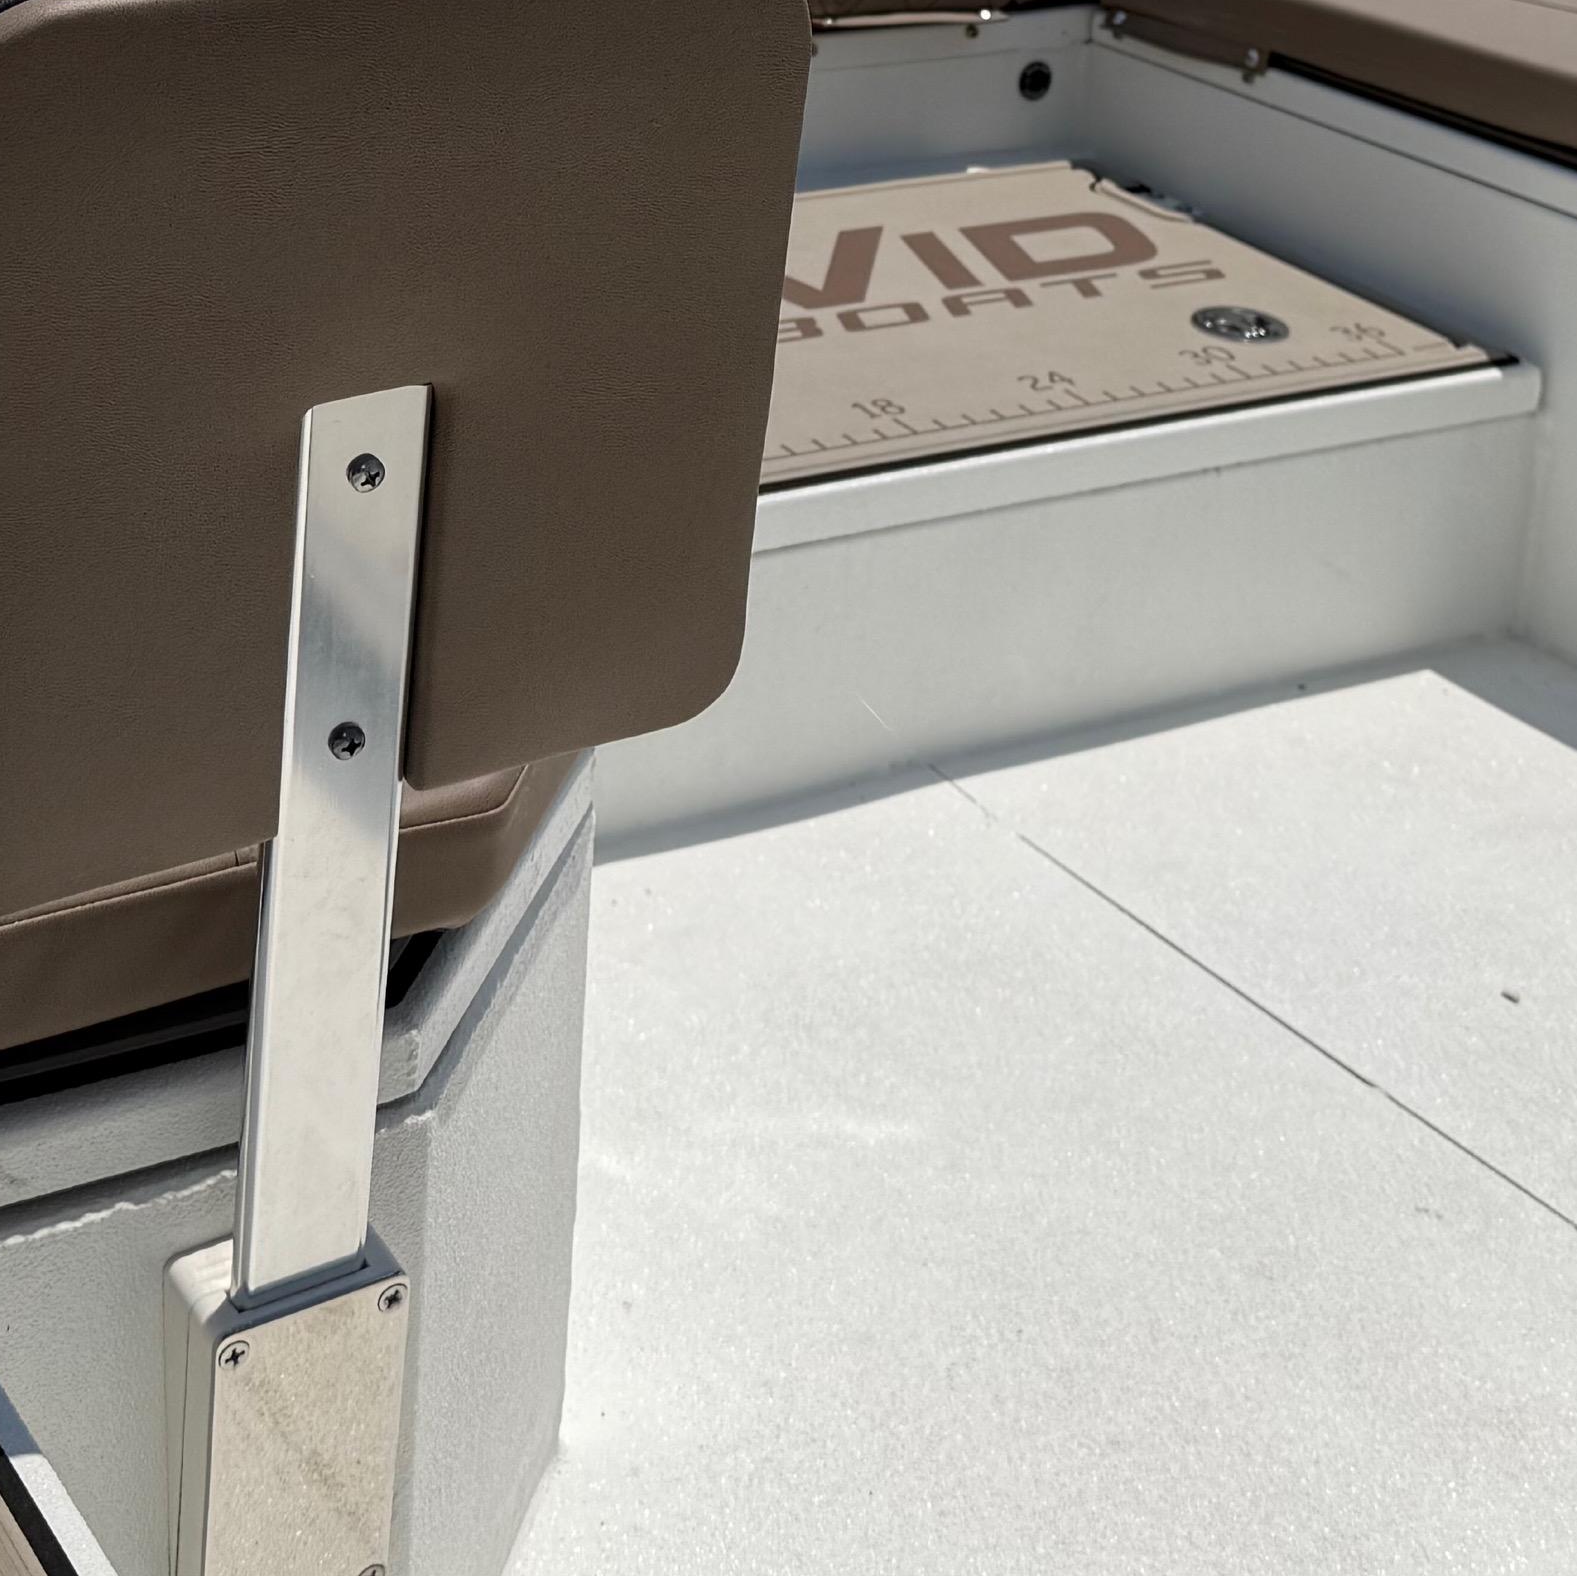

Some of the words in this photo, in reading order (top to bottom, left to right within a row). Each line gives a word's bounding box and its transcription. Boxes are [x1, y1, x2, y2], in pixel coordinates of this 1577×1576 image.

[851, 398, 906, 420] 18
[1018, 370, 1076, 393] 24
[1179, 345, 1236, 366] 30
[1330, 323, 1386, 342] 36
